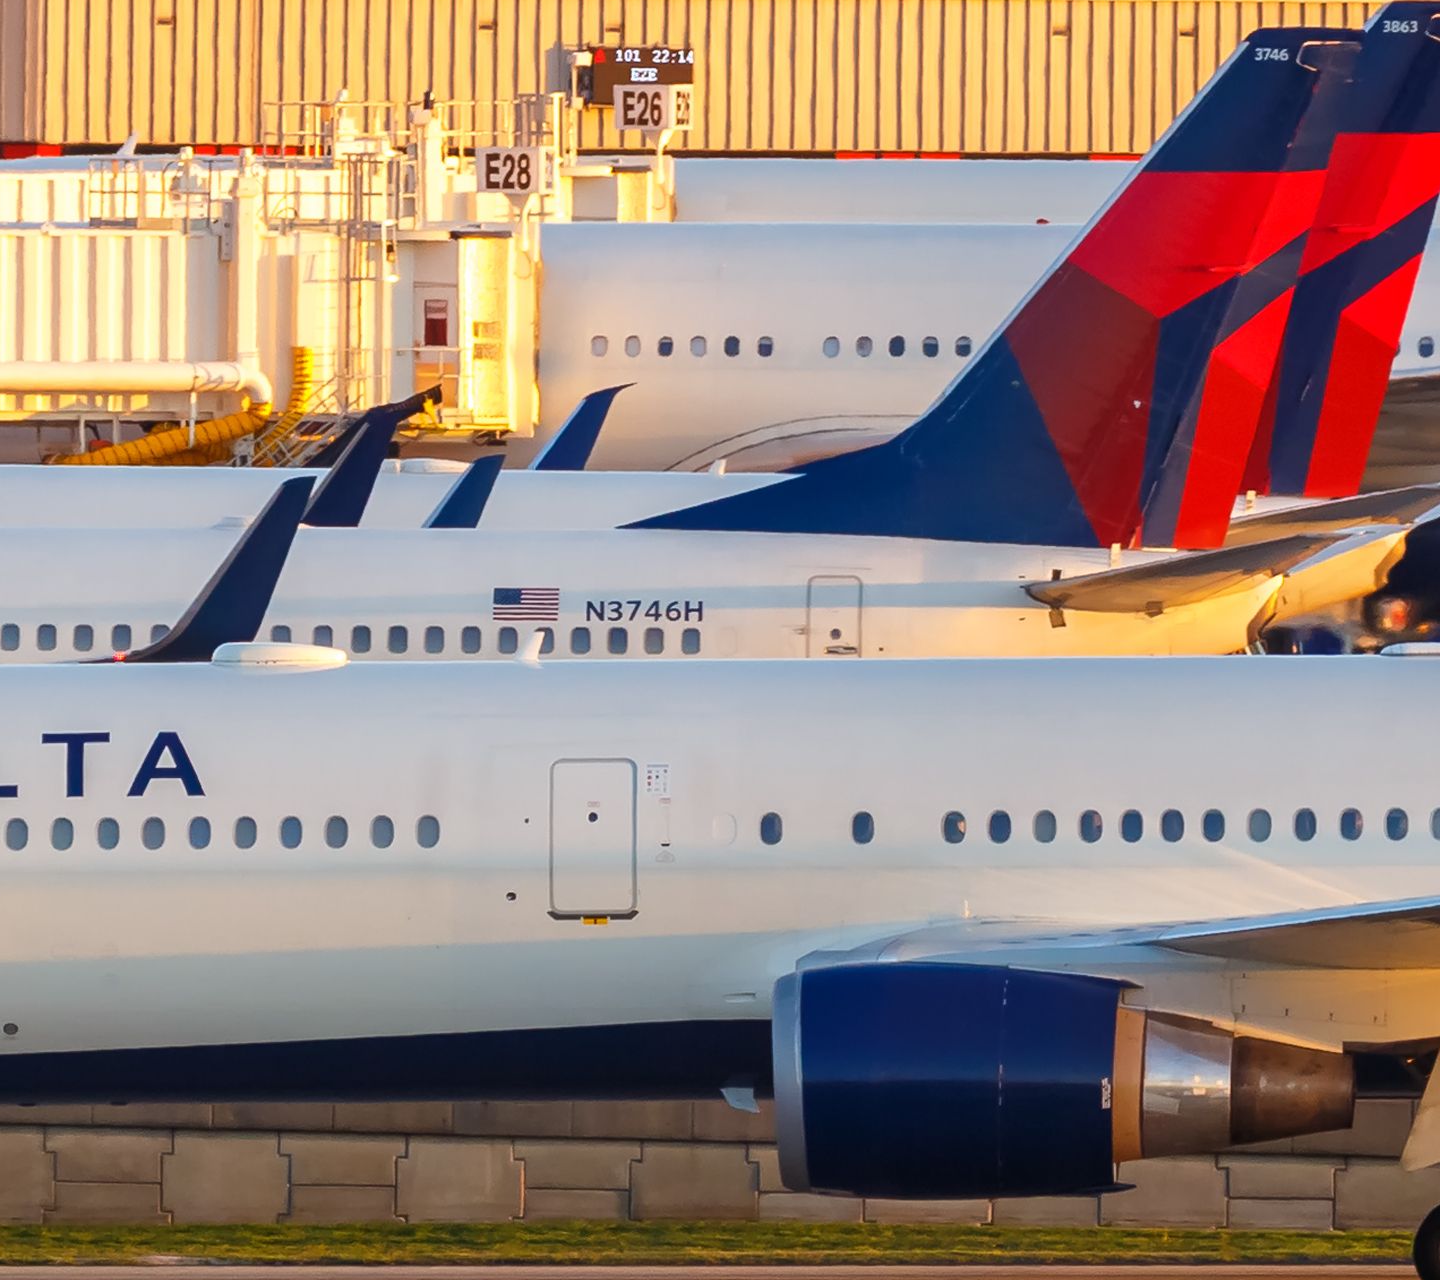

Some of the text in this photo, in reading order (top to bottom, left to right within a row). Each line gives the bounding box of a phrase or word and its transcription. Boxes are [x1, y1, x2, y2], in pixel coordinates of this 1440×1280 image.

[1383, 21, 1418, 33] 3863
[615, 49, 694, 63] 101 22:14
[1254, 48, 1289, 61] 3746
[623, 91, 662, 126] E26
[485, 153, 531, 190] E28
[585, 600, 704, 622] N3746H
